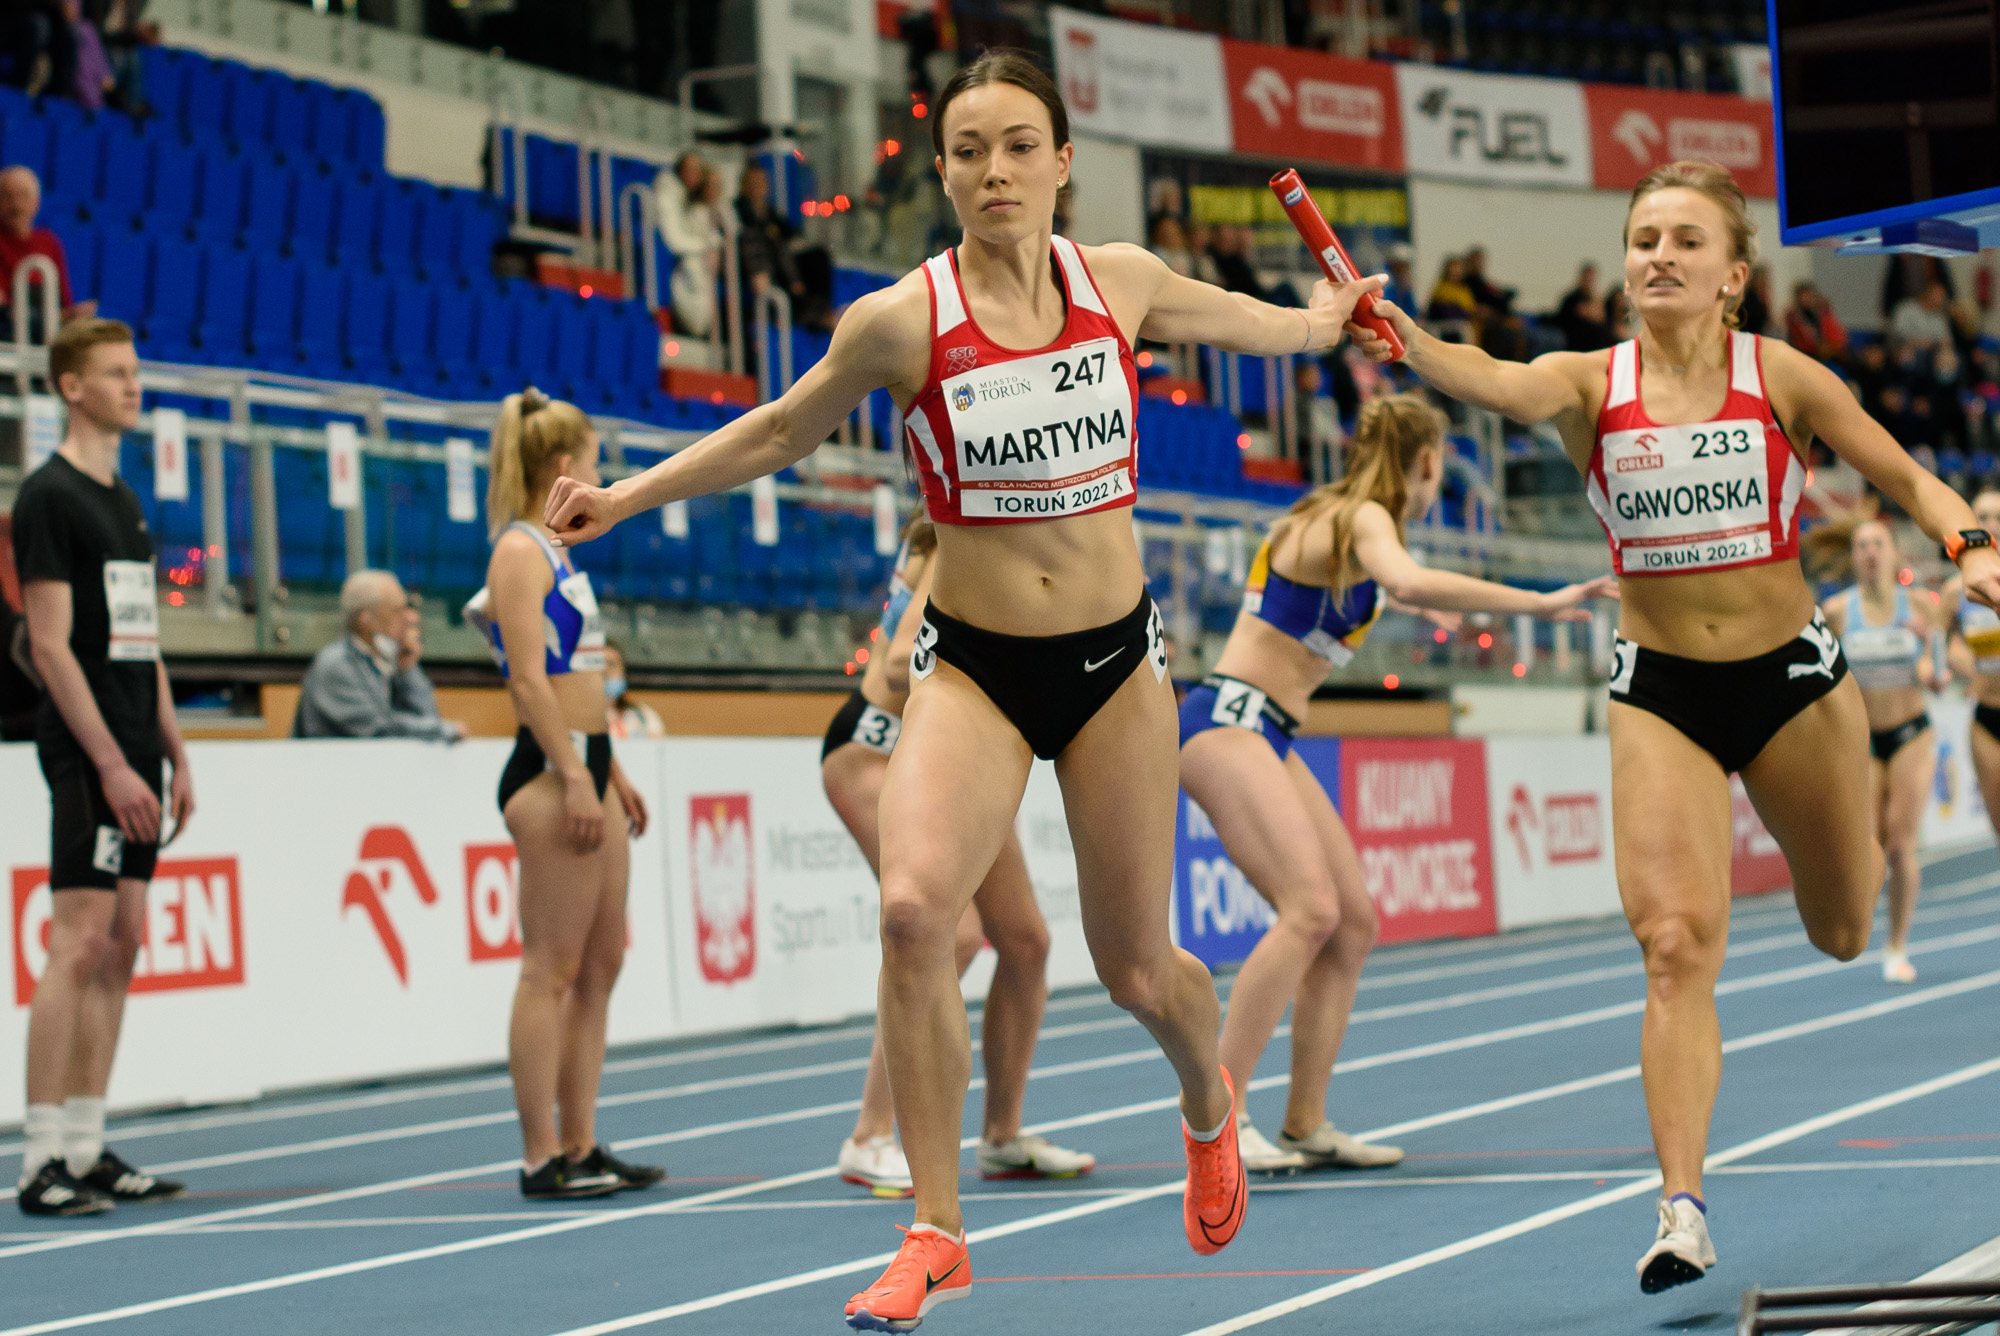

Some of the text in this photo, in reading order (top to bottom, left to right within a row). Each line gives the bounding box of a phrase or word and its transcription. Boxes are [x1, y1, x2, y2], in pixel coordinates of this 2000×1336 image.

[1450, 106, 1567, 166] FUEL
[979, 376, 1018, 389] MIASTO
[1051, 352, 1106, 393] 247
[979, 378, 1033, 401] TORUŃ
[964, 408, 1127, 467] MARTYNA
[1691, 429, 1750, 459] 233
[1050, 471, 1098, 488] MISTRZOSTWA
[1098, 462, 1118, 477] POLSKI
[1618, 456, 1661, 472] ORLEN
[994, 482, 1109, 512] TORUŃ 2022
[1616, 477, 1762, 520] GAWORSKA
[1643, 542, 1748, 567] TORUŃ 2022
[1225, 691, 1252, 722] 4
[865, 713, 891, 747] 3
[21, 871, 234, 982] OEN
